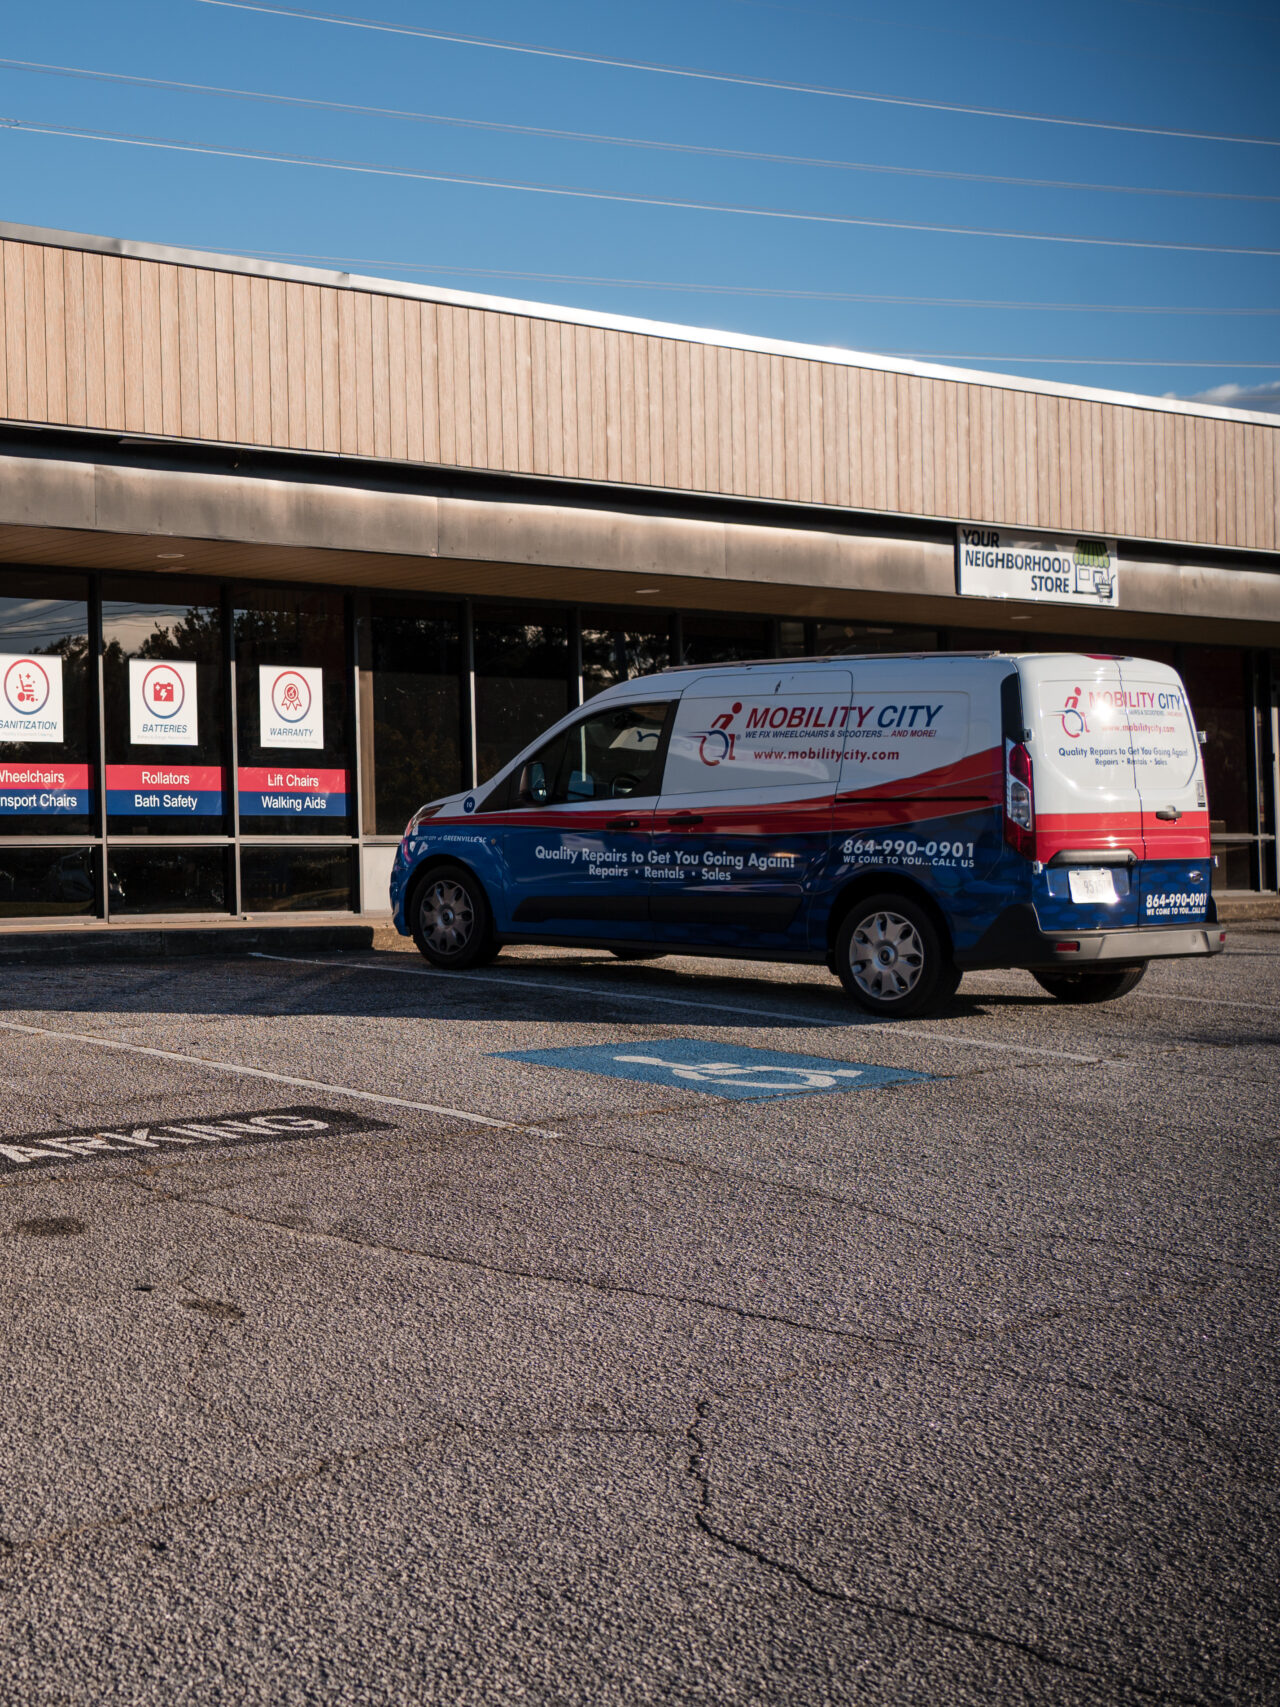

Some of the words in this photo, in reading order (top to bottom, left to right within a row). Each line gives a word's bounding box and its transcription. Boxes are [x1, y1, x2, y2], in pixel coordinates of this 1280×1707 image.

[963, 529, 1000, 548] YOUR
[965, 549, 1071, 574] NEIGHBORHOOD
[1031, 575, 1069, 593] STORE
[1158, 693, 1181, 710] CITY
[745, 706, 875, 729] MOBILITY
[877, 705, 944, 728] CITY
[142, 723, 188, 733] BATTERIES
[269, 727, 314, 737] WARRANTY
[772, 730, 829, 738] WHEELCHAIRS
[829, 730, 835, 738] &
[891, 730, 908, 738] AND
[910, 729, 937, 738] MORE!
[753, 747, 900, 763] www.mobilitycity.com
[1058, 747, 1088, 758] Quality
[1089, 747, 1117, 757] Repairs
[1128, 747, 1140, 755] Get
[1141, 747, 1152, 755] You
[1153, 747, 1171, 757] Going
[1095, 758, 1118, 766] Repairs
[1127, 758, 1147, 766] Rentals
[1154, 758, 1168, 766] Sales
[141, 771, 190, 785] Rollators
[267, 774, 284, 787] Lift
[286, 774, 319, 787] Chairs
[40, 793, 77, 808] Chairs
[134, 794, 161, 807] Bath
[163, 795, 198, 811] Safety
[261, 795, 302, 811] Walking
[303, 796, 327, 809] Aids
[443, 835, 479, 843] GREENVILLE
[843, 839, 974, 858] 864-990-0901
[535, 845, 578, 864] Quality
[582, 848, 628, 866] Repairs
[631, 850, 644, 863] to
[648, 850, 671, 864] Get
[675, 851, 699, 865] You
[703, 851, 744, 869] Going
[747, 853, 795, 871] Again!
[843, 855, 856, 863] WE
[858, 855, 883, 864] COME
[887, 856, 899, 864] TO
[902, 857, 957, 867] YOU...CALL
[961, 860, 975, 868] US
[589, 864, 628, 879] Repairs
[645, 866, 684, 879] Rentals
[702, 868, 731, 881] Sales
[1146, 893, 1207, 908] 864-990-0901
[1146, 908, 1154, 916] WE
[1155, 907, 1170, 915] COME
